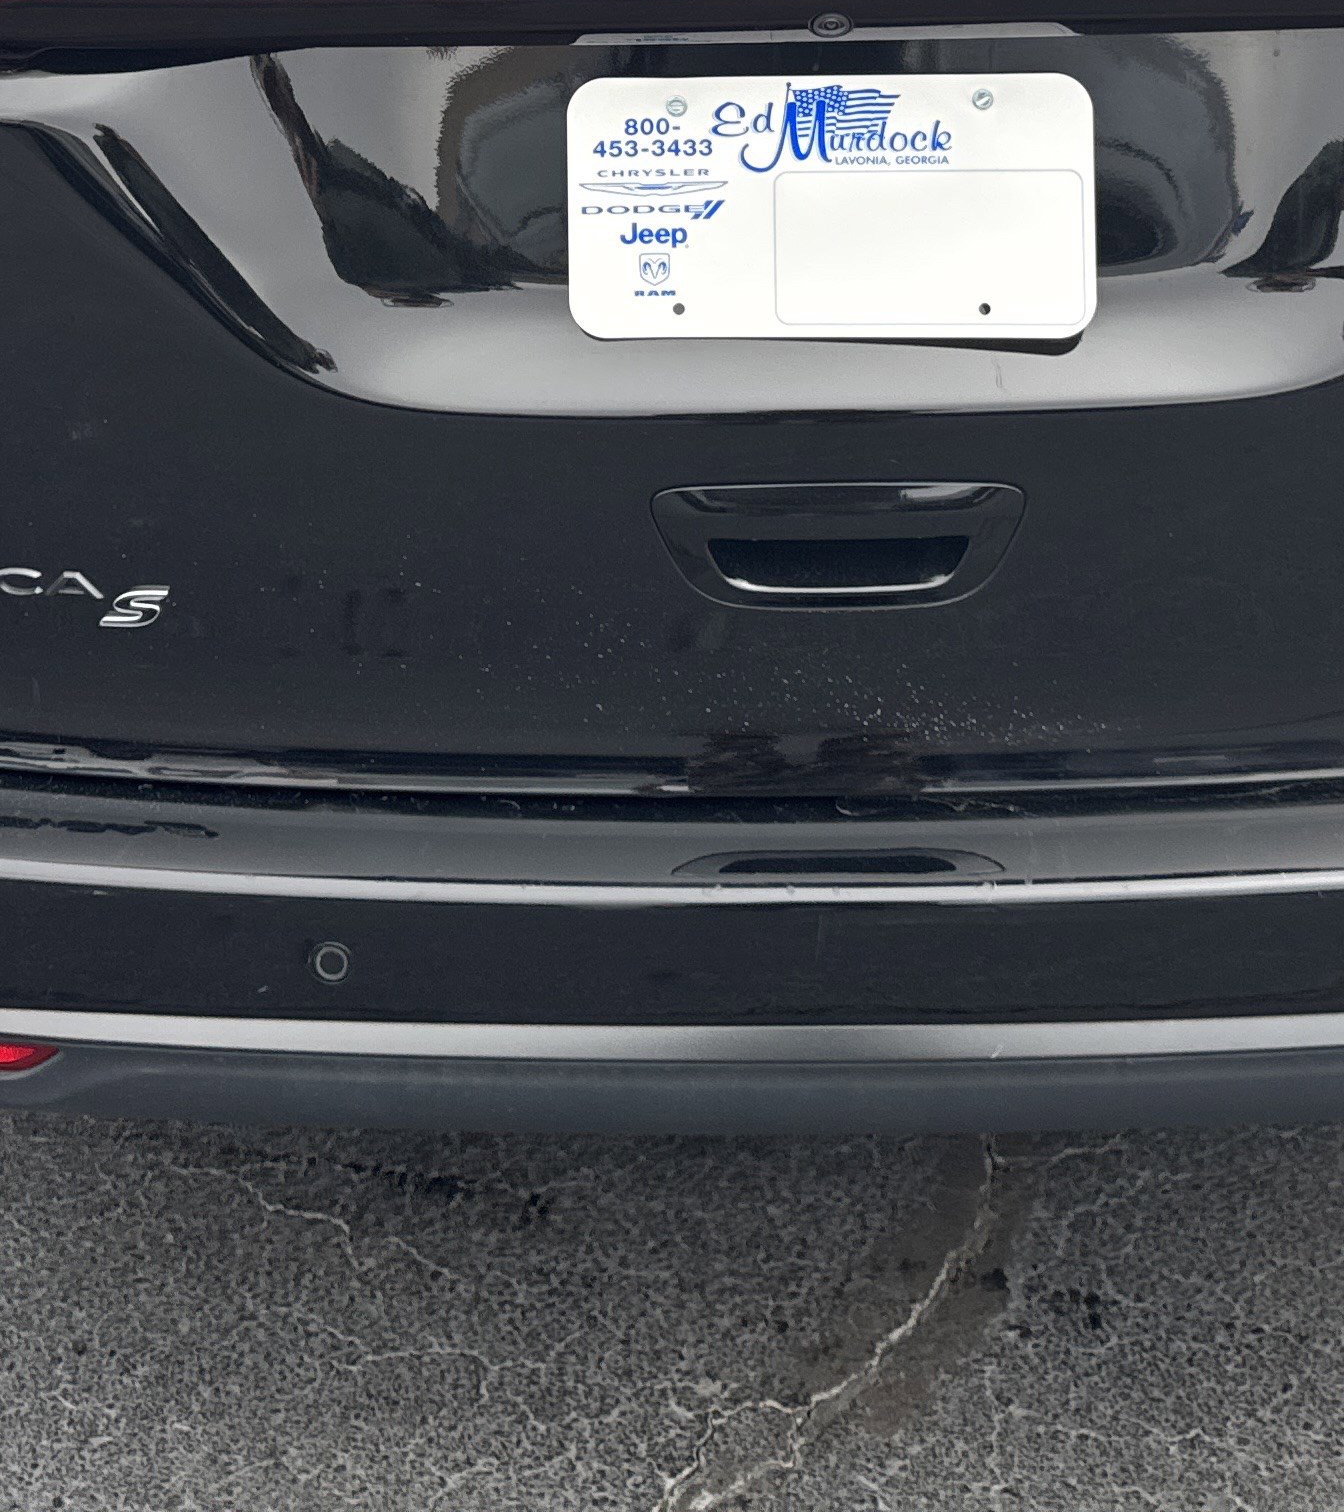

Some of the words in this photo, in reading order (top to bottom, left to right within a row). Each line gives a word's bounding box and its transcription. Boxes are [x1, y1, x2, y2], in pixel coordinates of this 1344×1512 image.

[624, 117, 681, 136] 800-
[709, 101, 774, 137] Ed
[739, 99, 953, 172] Murdock
[592, 139, 713, 157] 453-3433
[835, 155, 891, 166] LAVONIA,
[895, 154, 949, 165] GEORGIA
[597, 168, 710, 177] CHRYSLER
[581, 203, 708, 218] DODGE
[620, 222, 688, 248] Jeep
[99, 585, 170, 628] S
